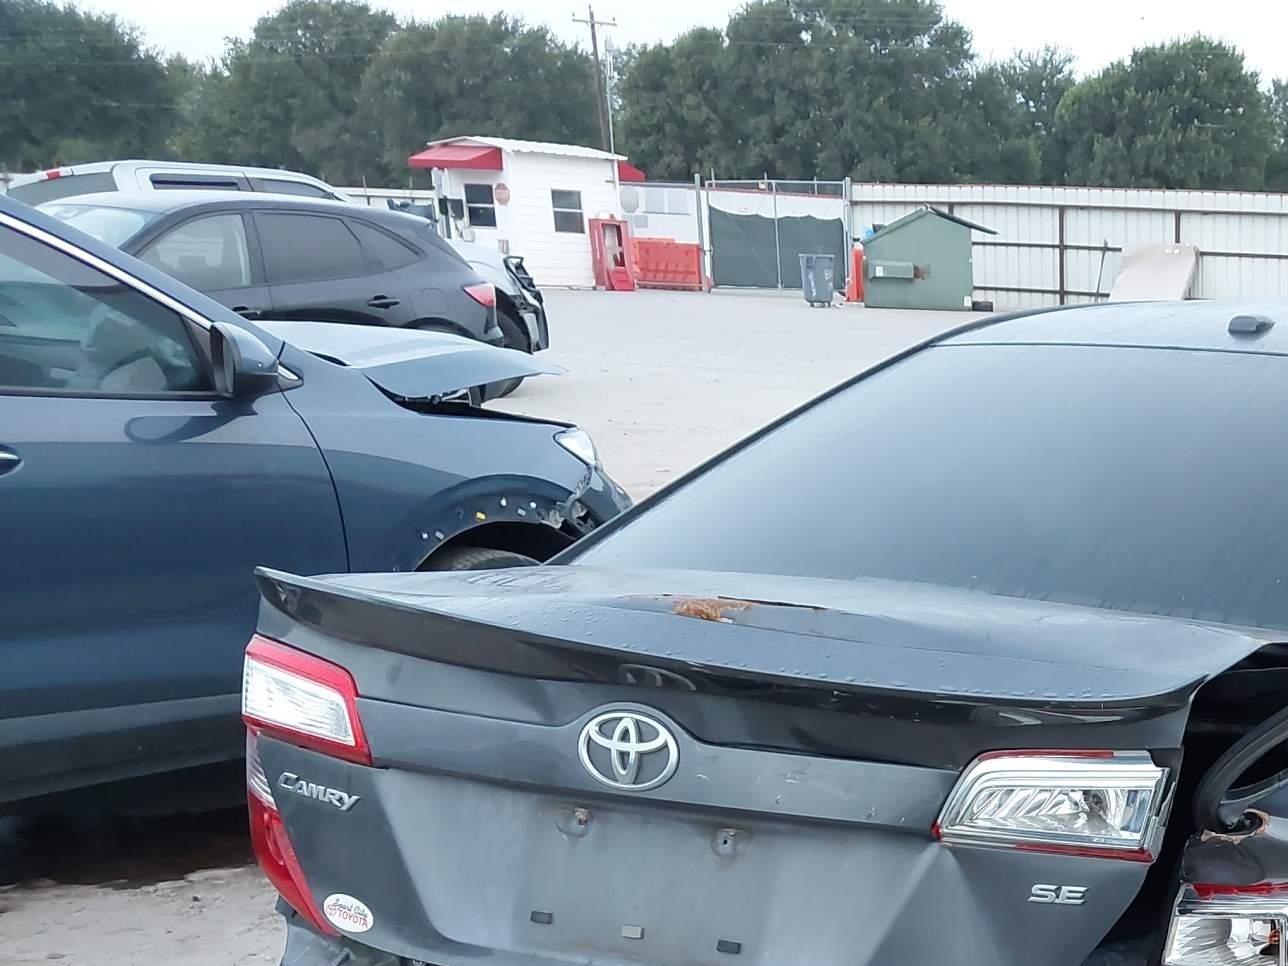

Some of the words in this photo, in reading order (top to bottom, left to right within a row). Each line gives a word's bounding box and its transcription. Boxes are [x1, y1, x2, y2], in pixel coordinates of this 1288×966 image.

[278, 771, 361, 811] CAMRY
[1028, 883, 1089, 905] SE
[338, 910, 369, 929] TOYOTA
